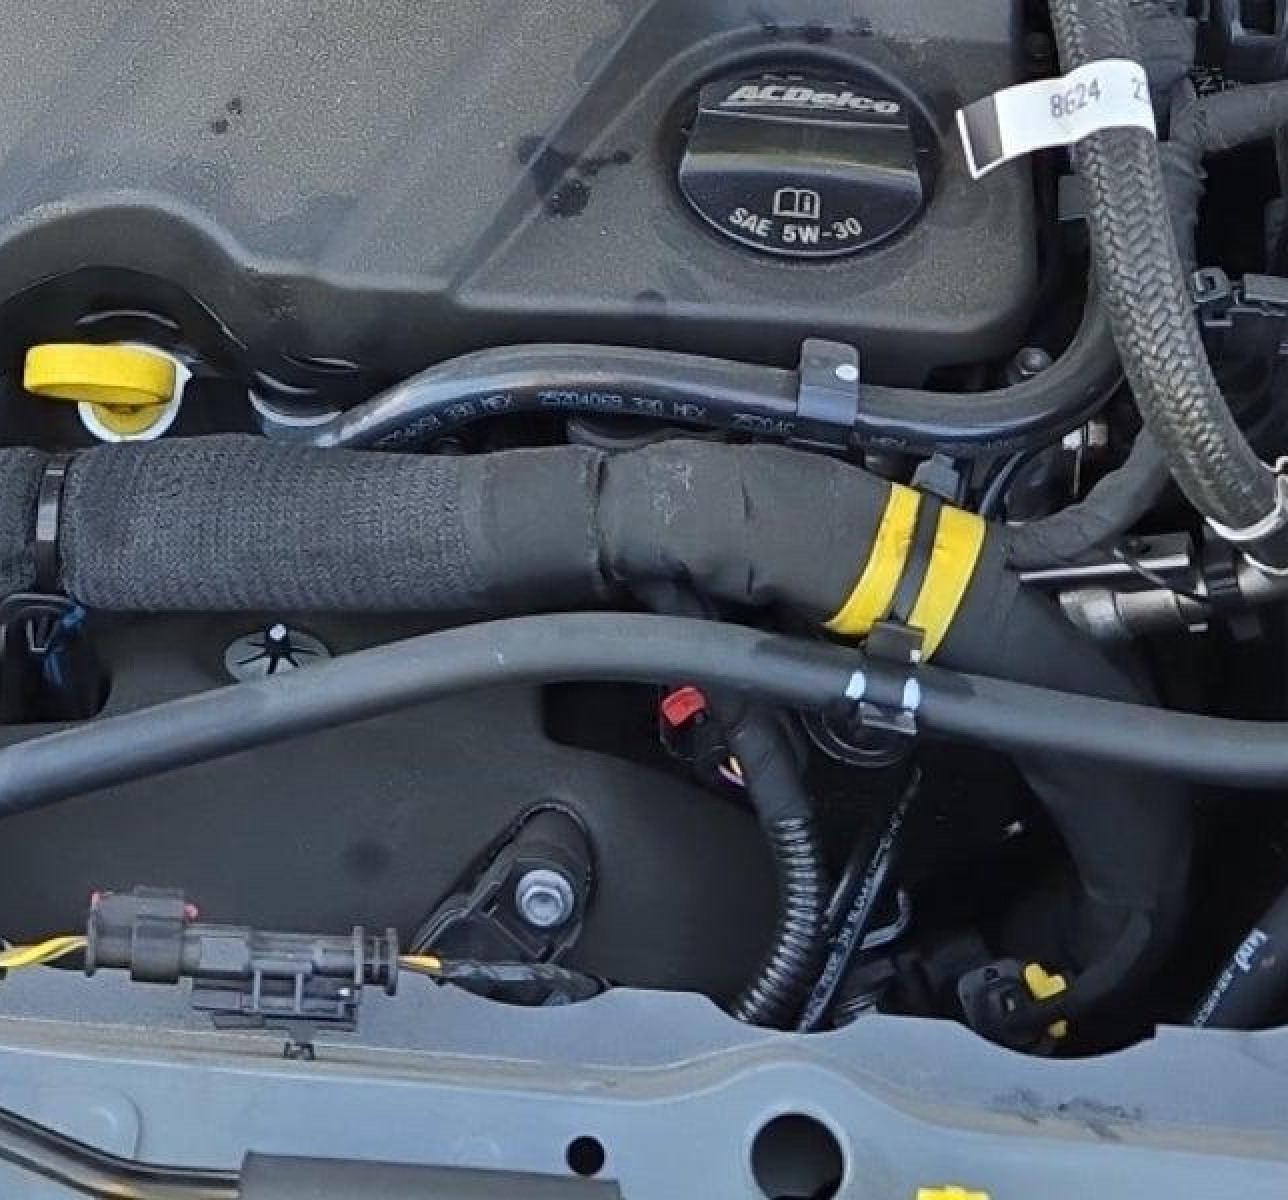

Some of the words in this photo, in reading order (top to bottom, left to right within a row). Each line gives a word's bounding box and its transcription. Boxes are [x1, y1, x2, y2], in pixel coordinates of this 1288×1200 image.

[720, 84, 901, 115] ACDelco
[729, 207, 774, 237] SAE
[781, 216, 862, 244] 5W-30
